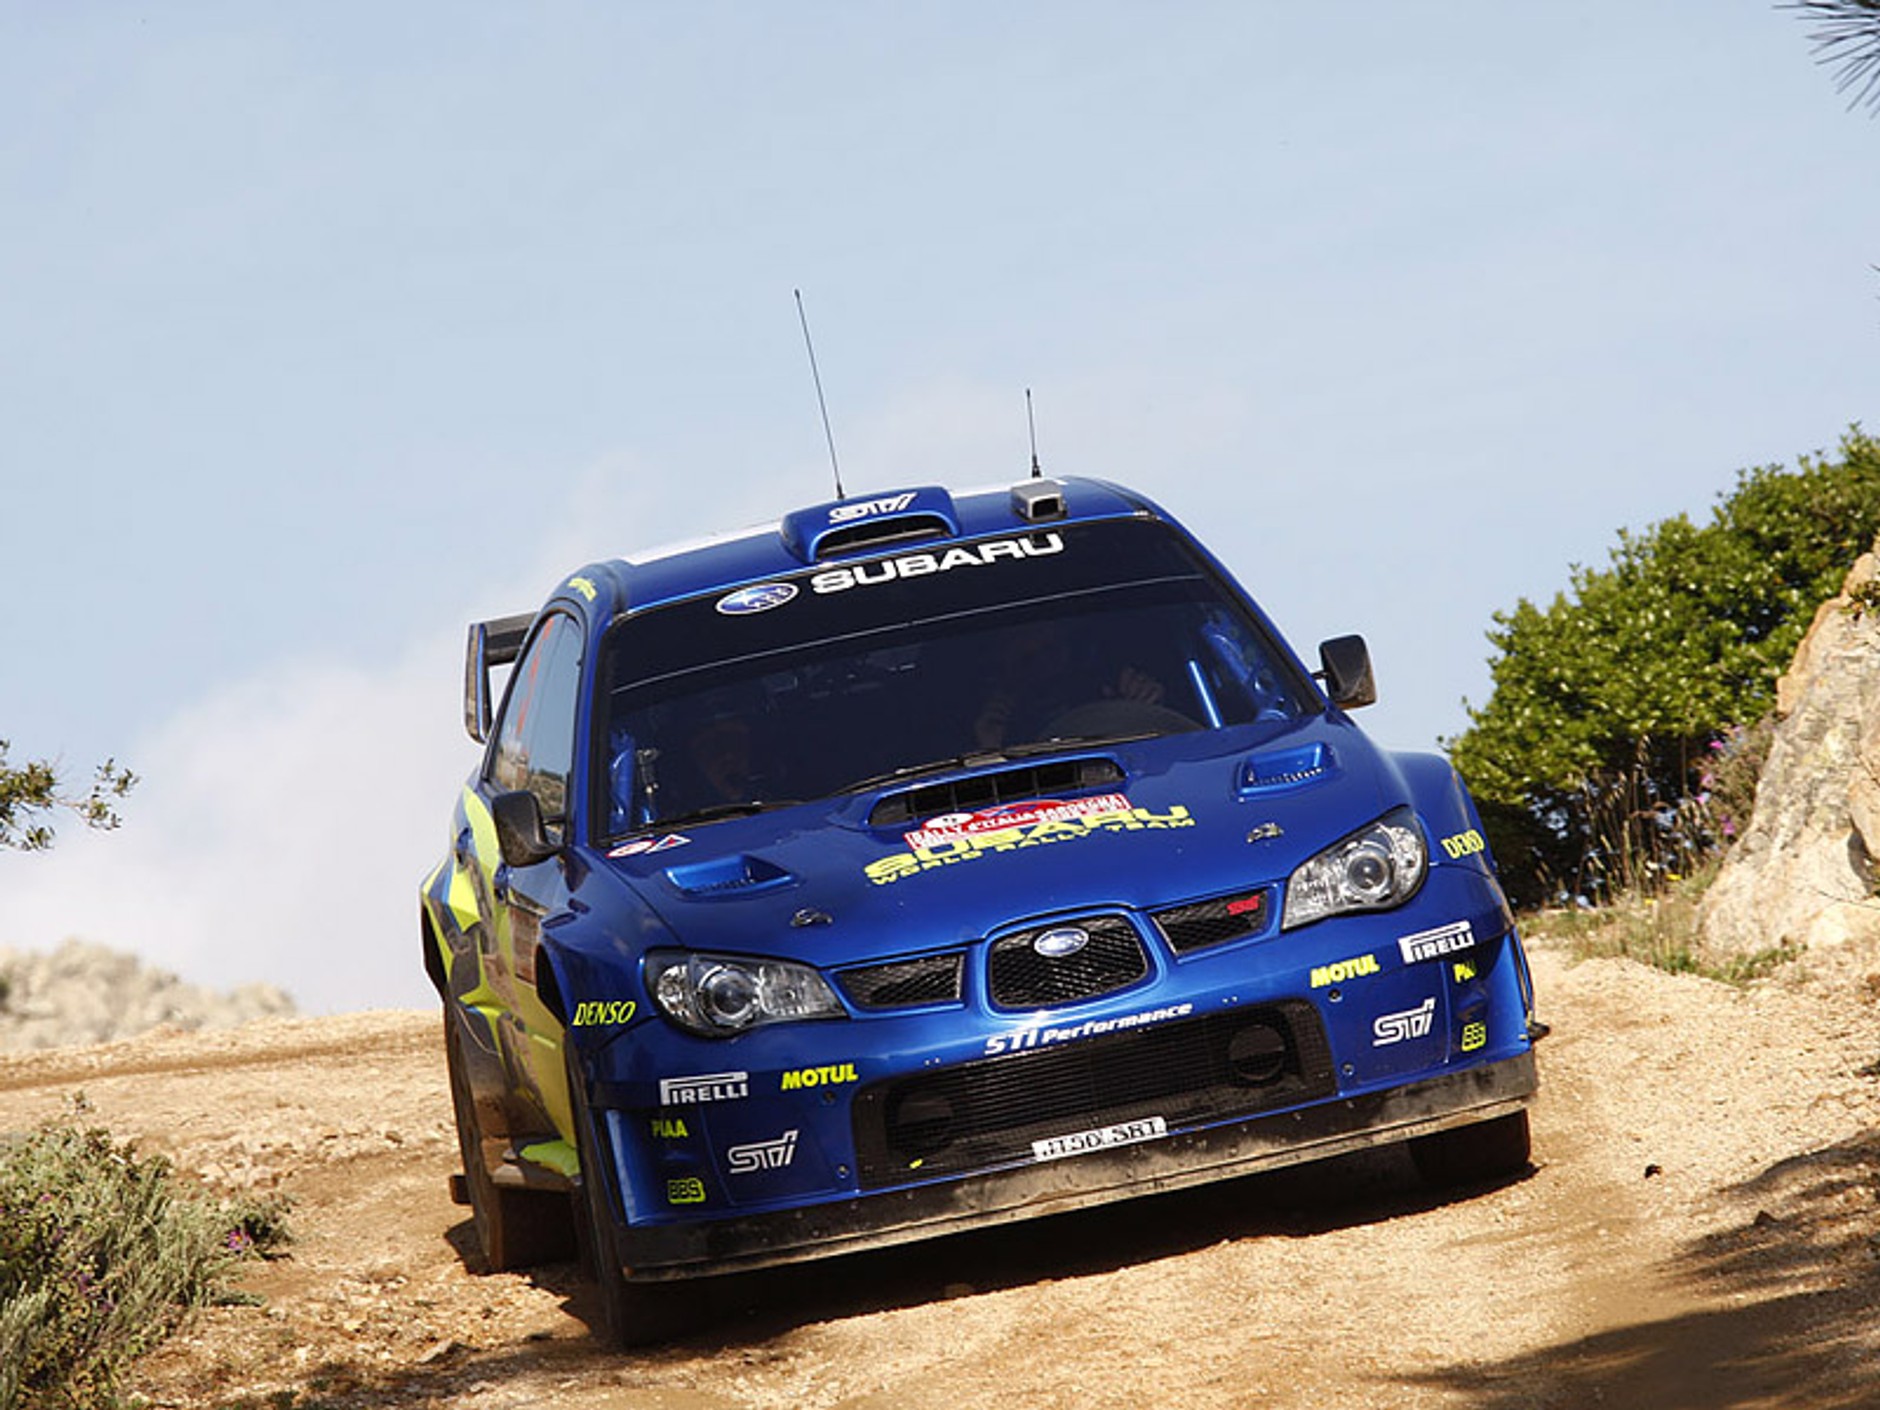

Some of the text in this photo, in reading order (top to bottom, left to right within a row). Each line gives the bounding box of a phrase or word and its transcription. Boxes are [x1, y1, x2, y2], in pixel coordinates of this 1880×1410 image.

[811, 534, 1064, 594] SUBARU
[864, 806, 1191, 879] SUBARU
[872, 817, 1196, 886] WORLD RALLY TEAM
[1398, 920, 1475, 965] PIRELLI
[1311, 954, 1380, 988] MOTUL
[573, 1001, 636, 1026] DENSO
[985, 1003, 1193, 1056] STI Performance
[660, 1071, 749, 1106] PIRELLI
[781, 1063, 859, 1091] MOTUL
[652, 1119, 689, 1138] PIAA
[668, 1178, 706, 1204] BBS
